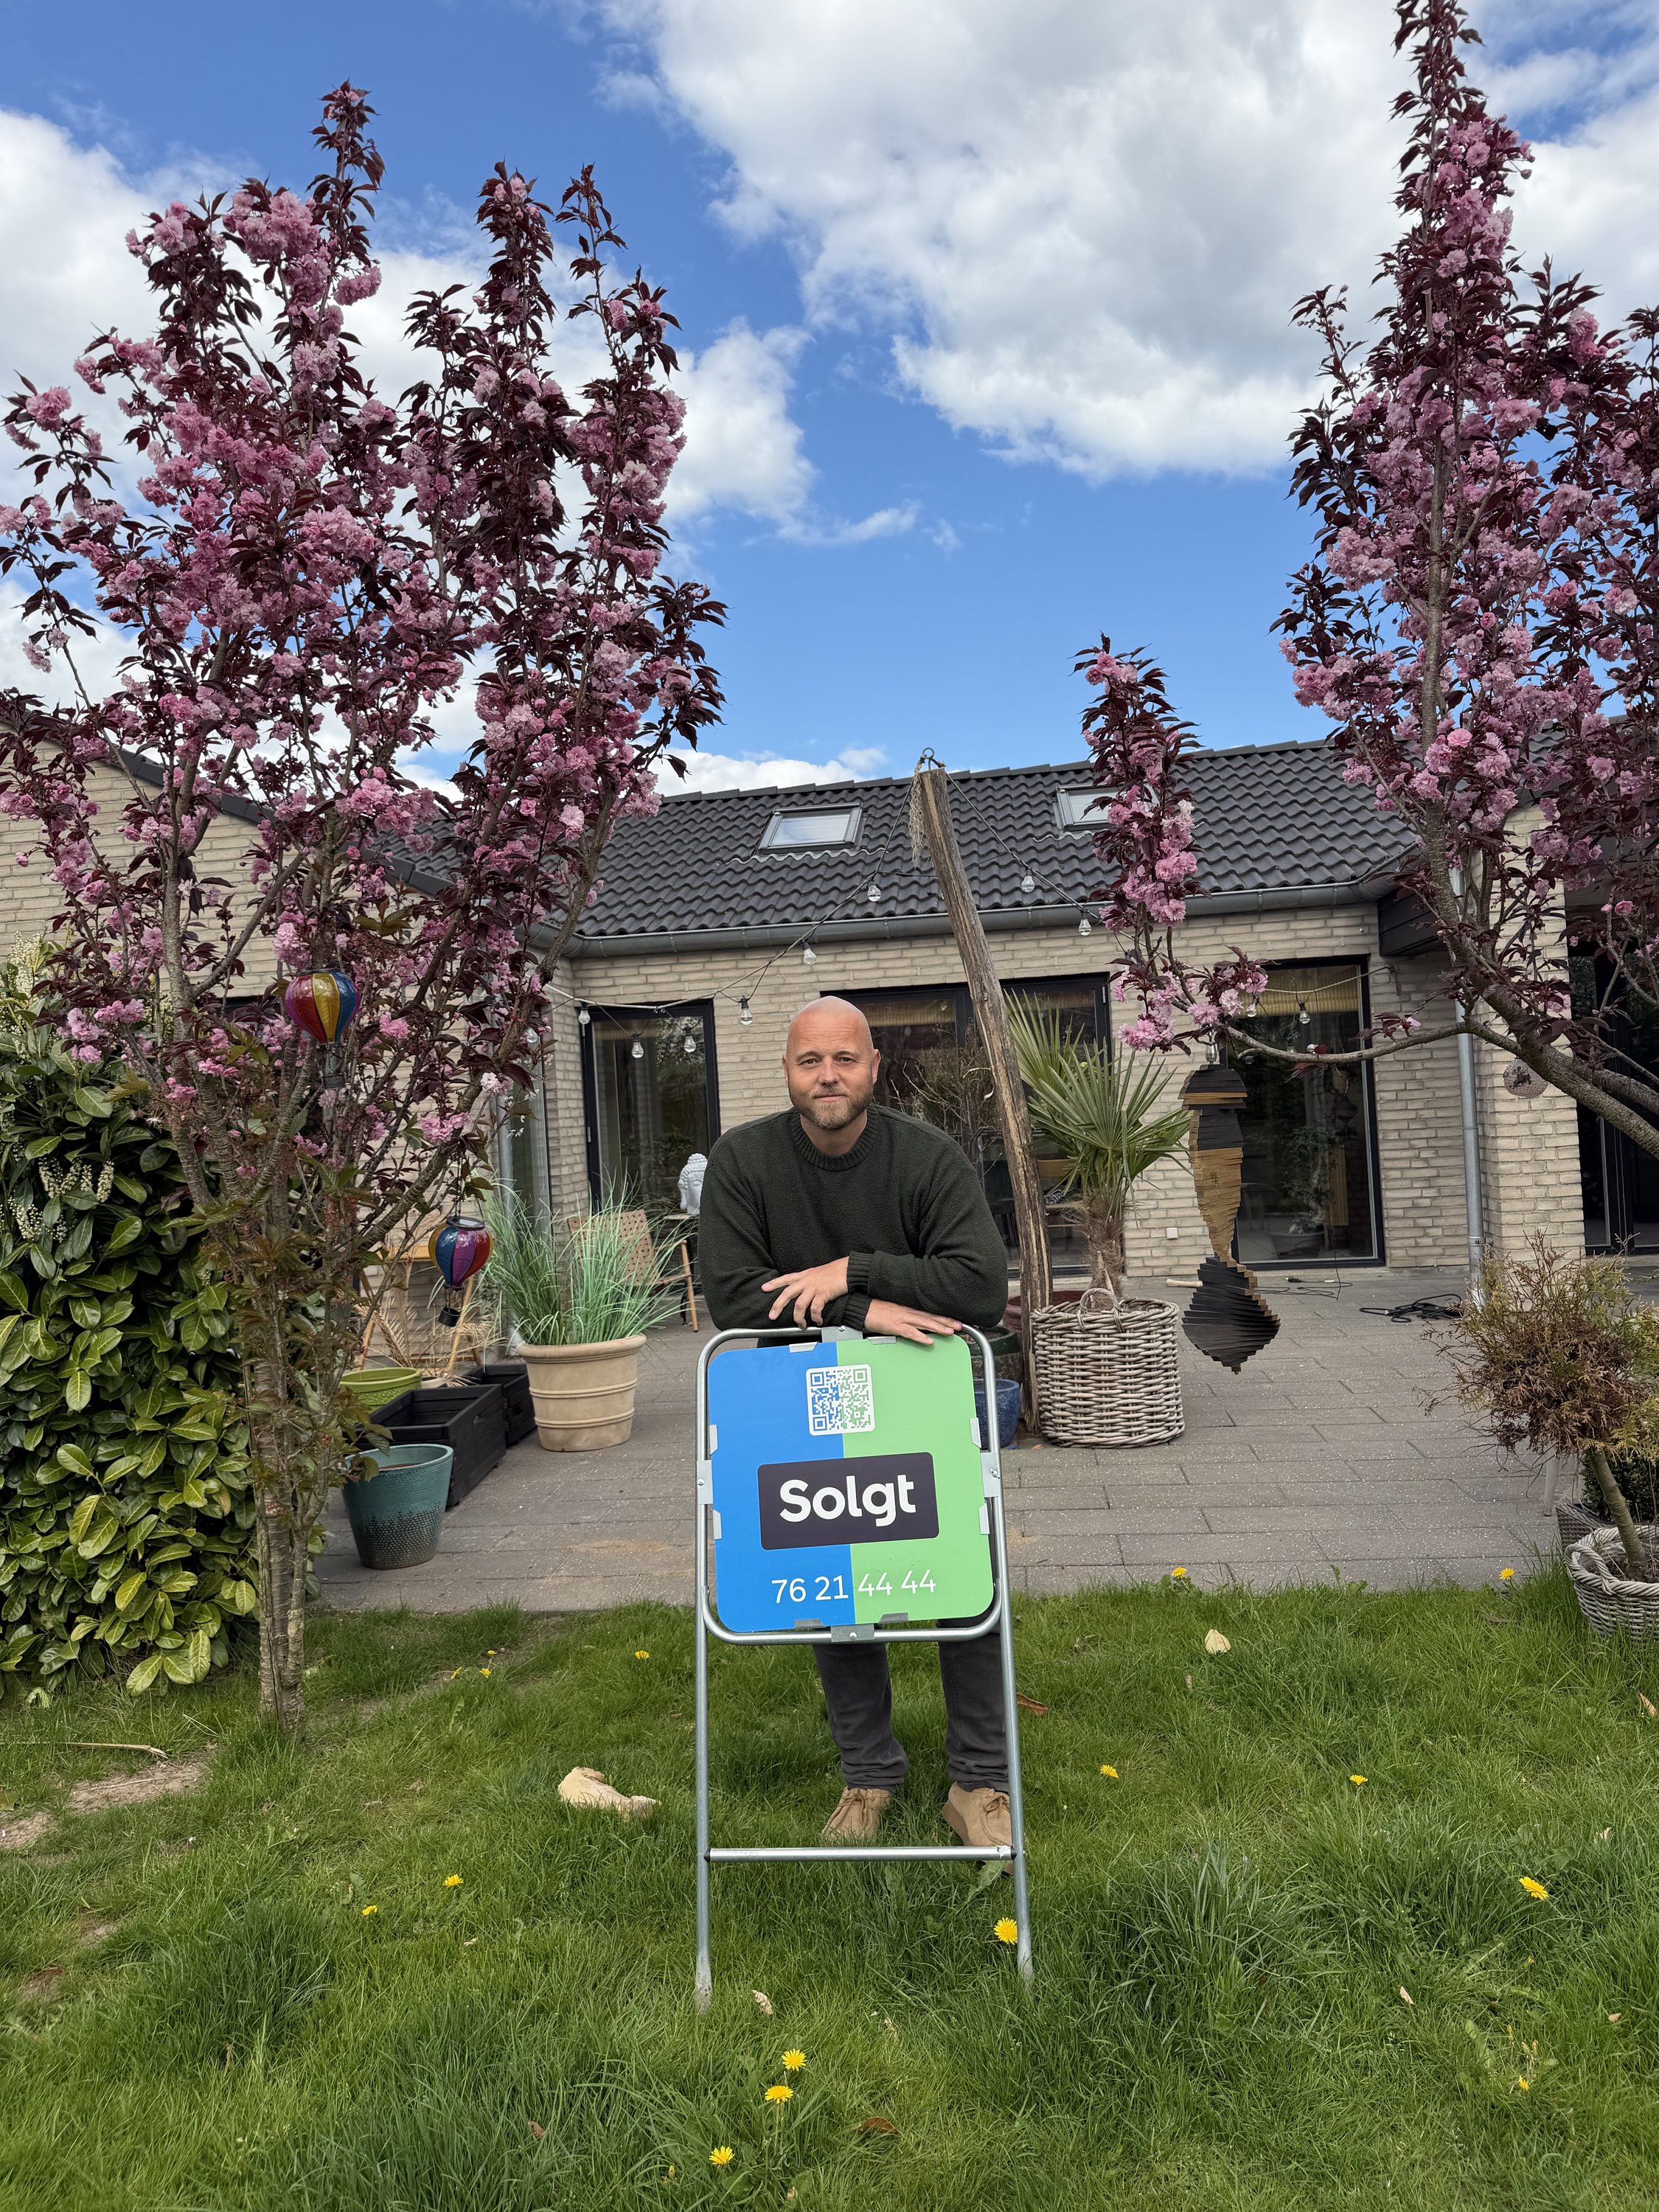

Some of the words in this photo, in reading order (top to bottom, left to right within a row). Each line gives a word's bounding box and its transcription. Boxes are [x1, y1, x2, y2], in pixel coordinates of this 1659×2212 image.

[779, 1474, 917, 1527] Solgt
[771, 1577, 807, 1603] 76
[814, 1575, 849, 1600] 21
[858, 1572, 893, 1597] 44
[901, 1569, 936, 1594] 44
